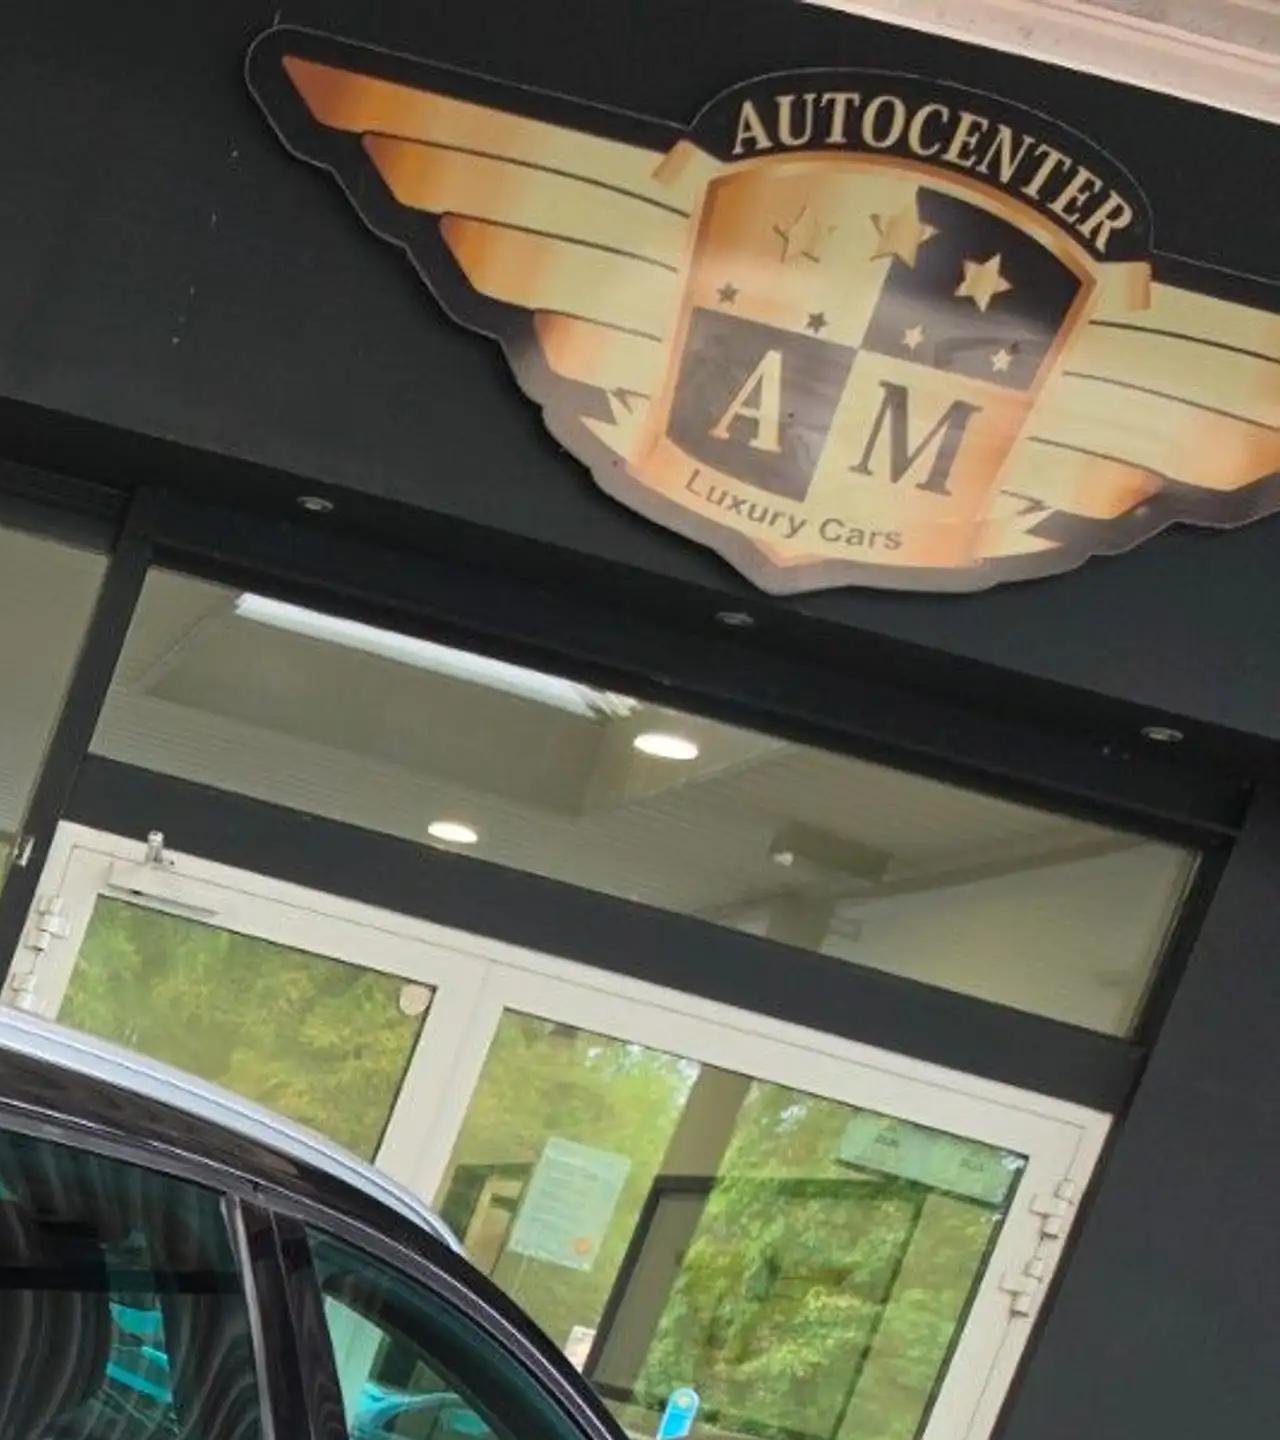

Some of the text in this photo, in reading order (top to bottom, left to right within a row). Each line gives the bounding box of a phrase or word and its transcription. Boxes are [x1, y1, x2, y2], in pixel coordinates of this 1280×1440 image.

[731, 91, 1134, 254] AUTOCENTER
[707, 348, 984, 496] A M
[684, 467, 904, 551] Luxury Cars
